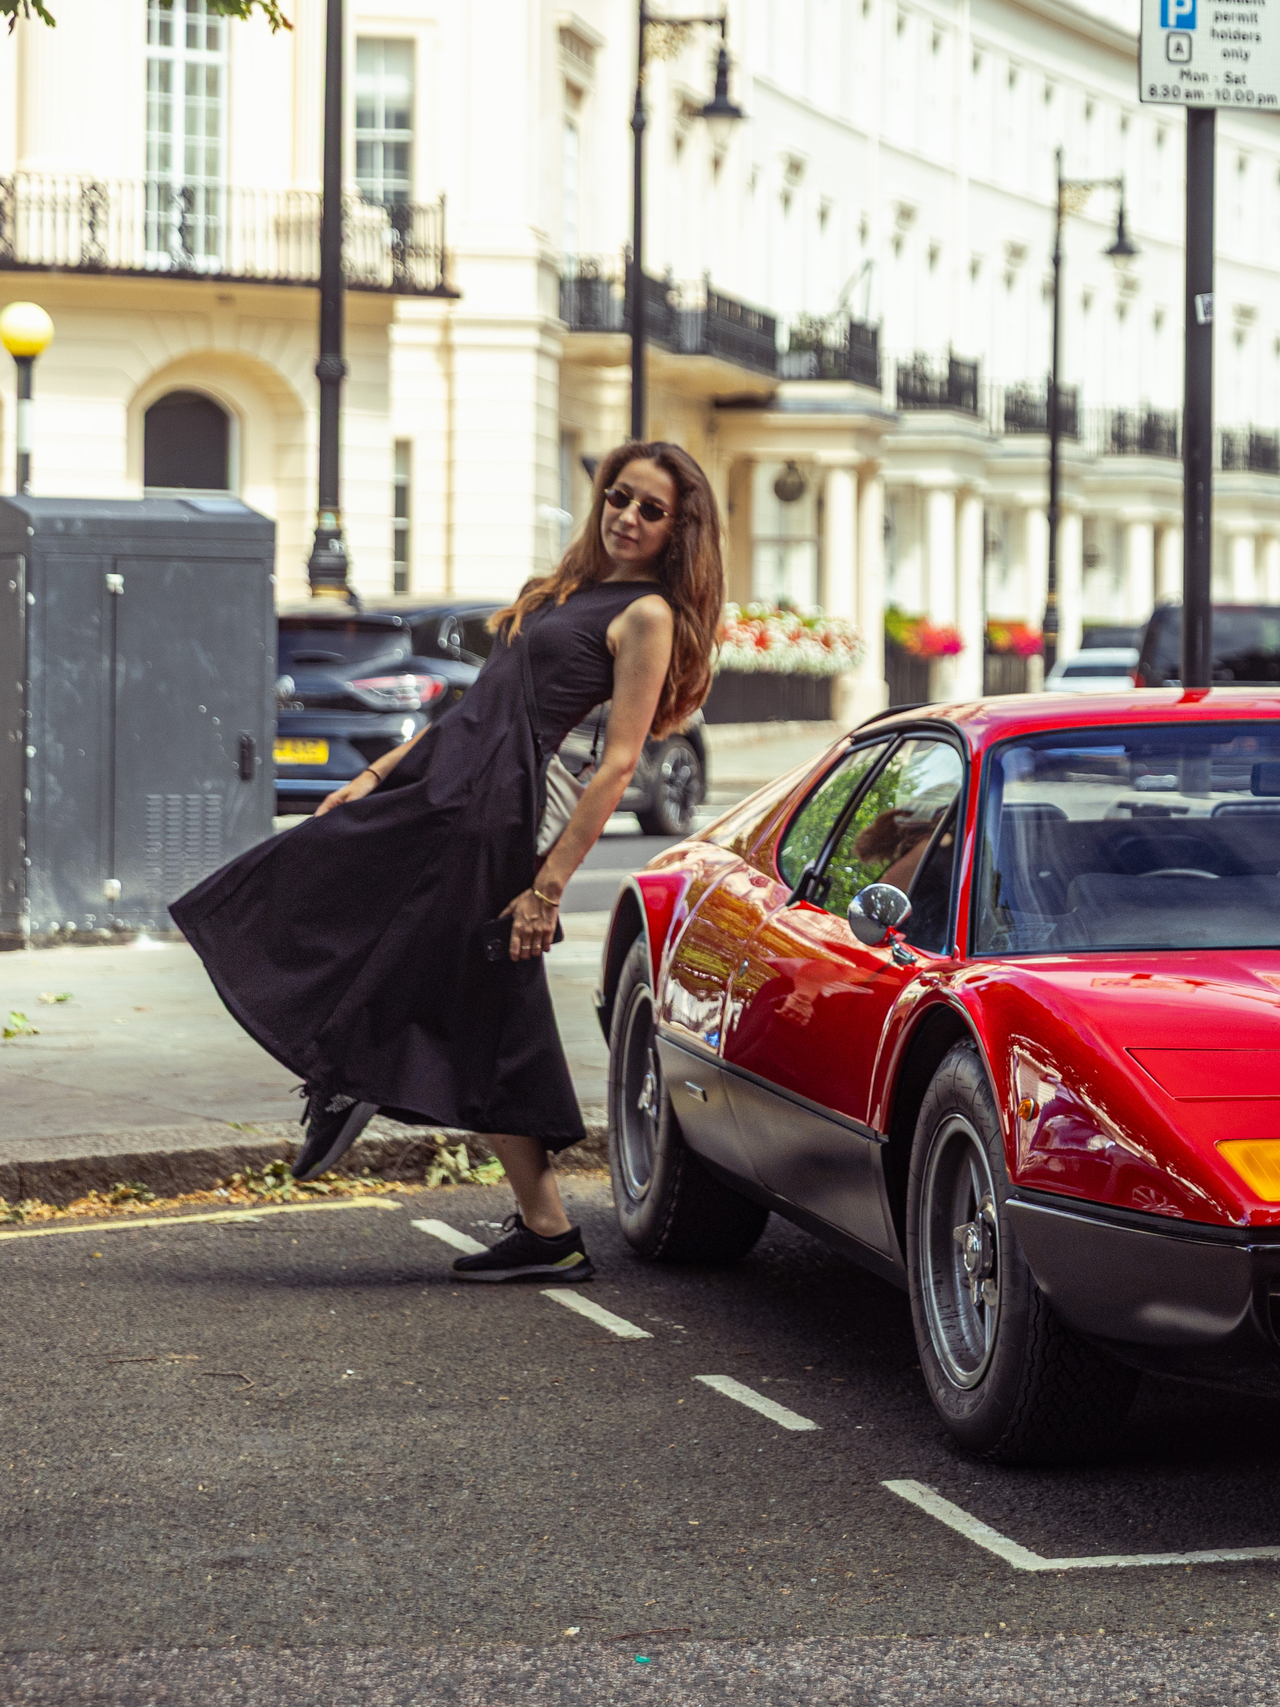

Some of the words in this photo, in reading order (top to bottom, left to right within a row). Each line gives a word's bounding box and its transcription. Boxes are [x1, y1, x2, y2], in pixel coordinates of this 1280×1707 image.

[1168, 0, 1193, 26] P
[1214, 11, 1258, 24] permit
[1211, 28, 1262, 43] holders
[1174, 41, 1184, 54] A
[1221, 46, 1251, 62] only
[1180, 68, 1210, 83] Mon
[1224, 71, 1247, 85] Sat
[1148, 84, 1181, 98] 8.30
[1185, 89, 1205, 101] am
[1257, 92, 1278, 106] pm
